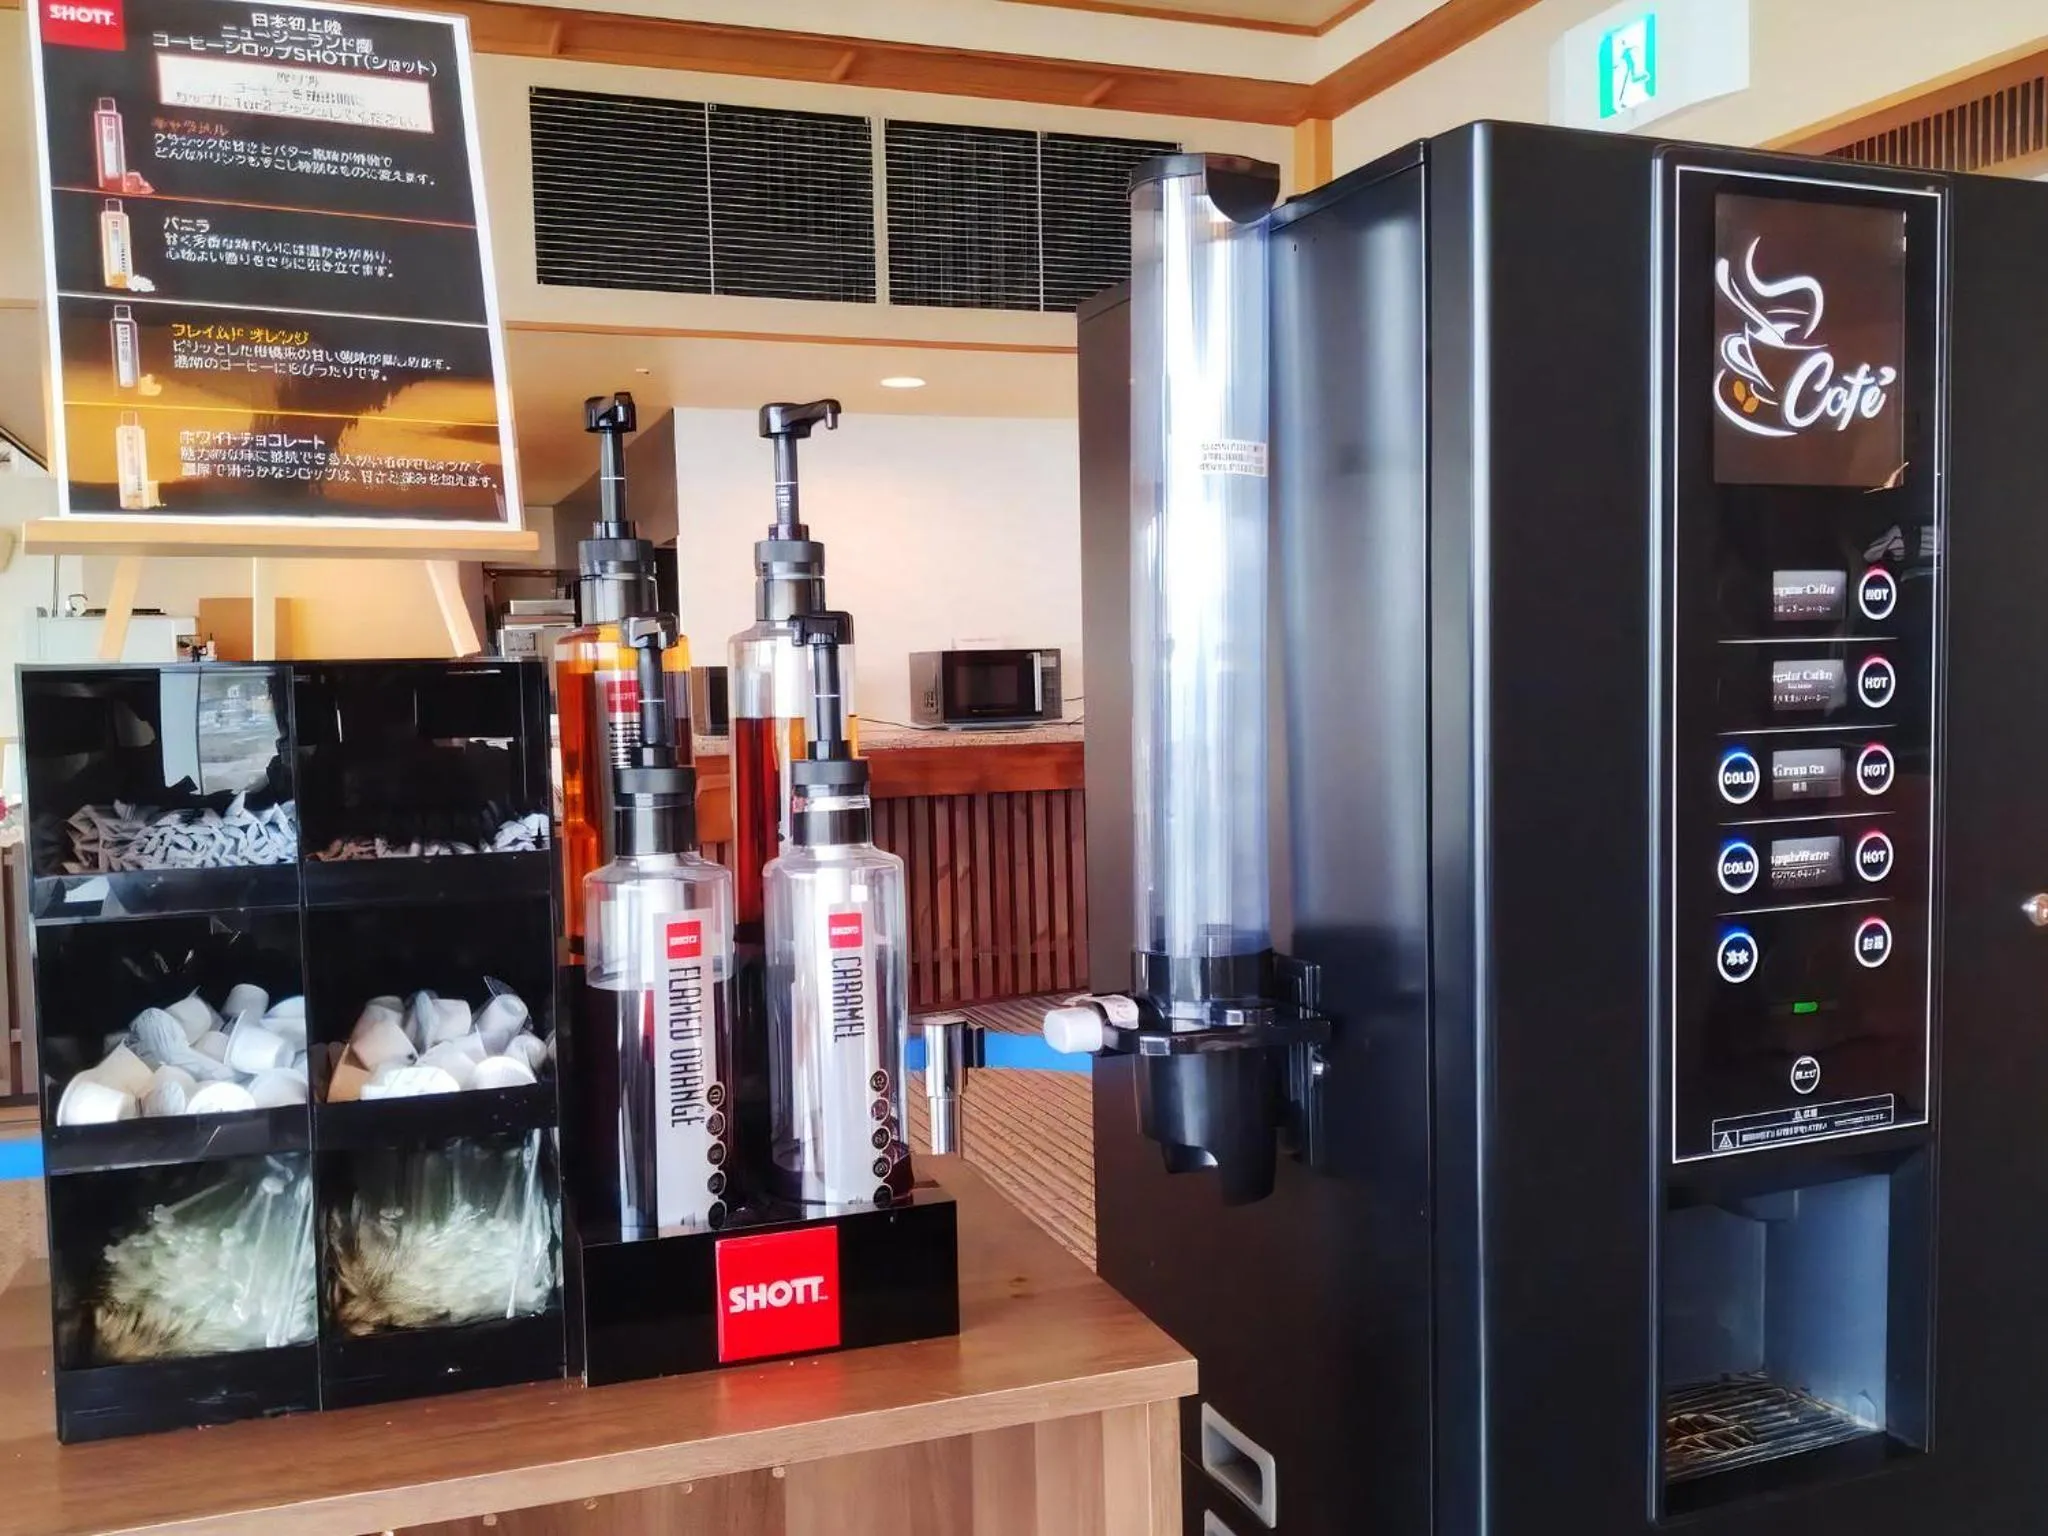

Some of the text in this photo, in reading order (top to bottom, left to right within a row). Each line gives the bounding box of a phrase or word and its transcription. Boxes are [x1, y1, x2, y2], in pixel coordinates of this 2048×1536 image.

[49, 4, 114, 25] SHOTT
[252, 12, 342, 36] 日本初上陸
[163, 216, 210, 233] バニラ
[1865, 588, 1889, 601] HOT
[1865, 677, 1888, 689] HOT
[1864, 763, 1888, 777] HOT
[1724, 772, 1754, 785] COLD
[1863, 850, 1886, 864] HOT
[1724, 862, 1753, 876] COLD
[831, 956, 865, 1044] CARAMEL
[668, 965, 706, 1129] FLAMED ORANGE
[728, 1275, 825, 1314] SHOTT
